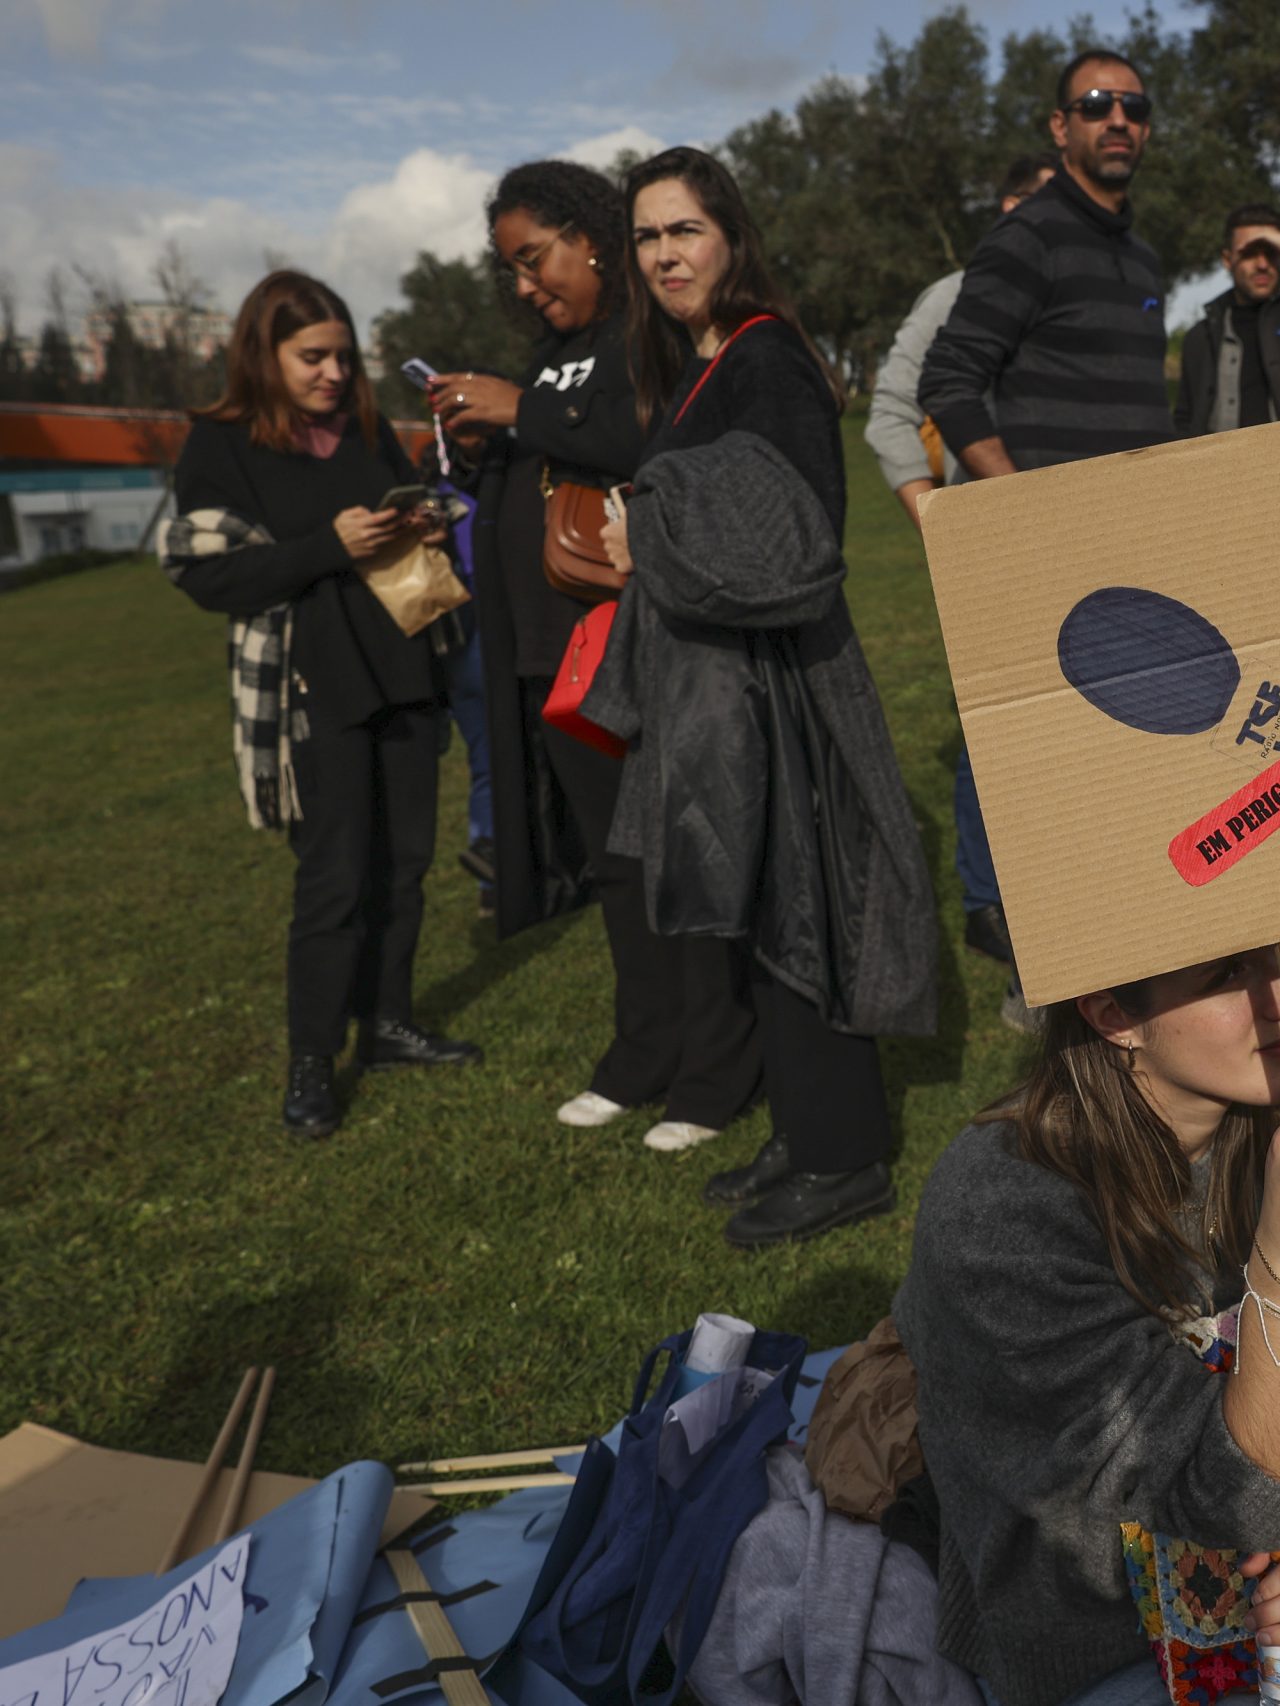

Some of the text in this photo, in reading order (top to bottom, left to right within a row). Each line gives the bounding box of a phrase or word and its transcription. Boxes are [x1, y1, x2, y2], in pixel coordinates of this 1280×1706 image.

[1196, 829, 1232, 865] EM
[221, 1548, 242, 1582] A
[62, 1562, 217, 1706] NOSSA
